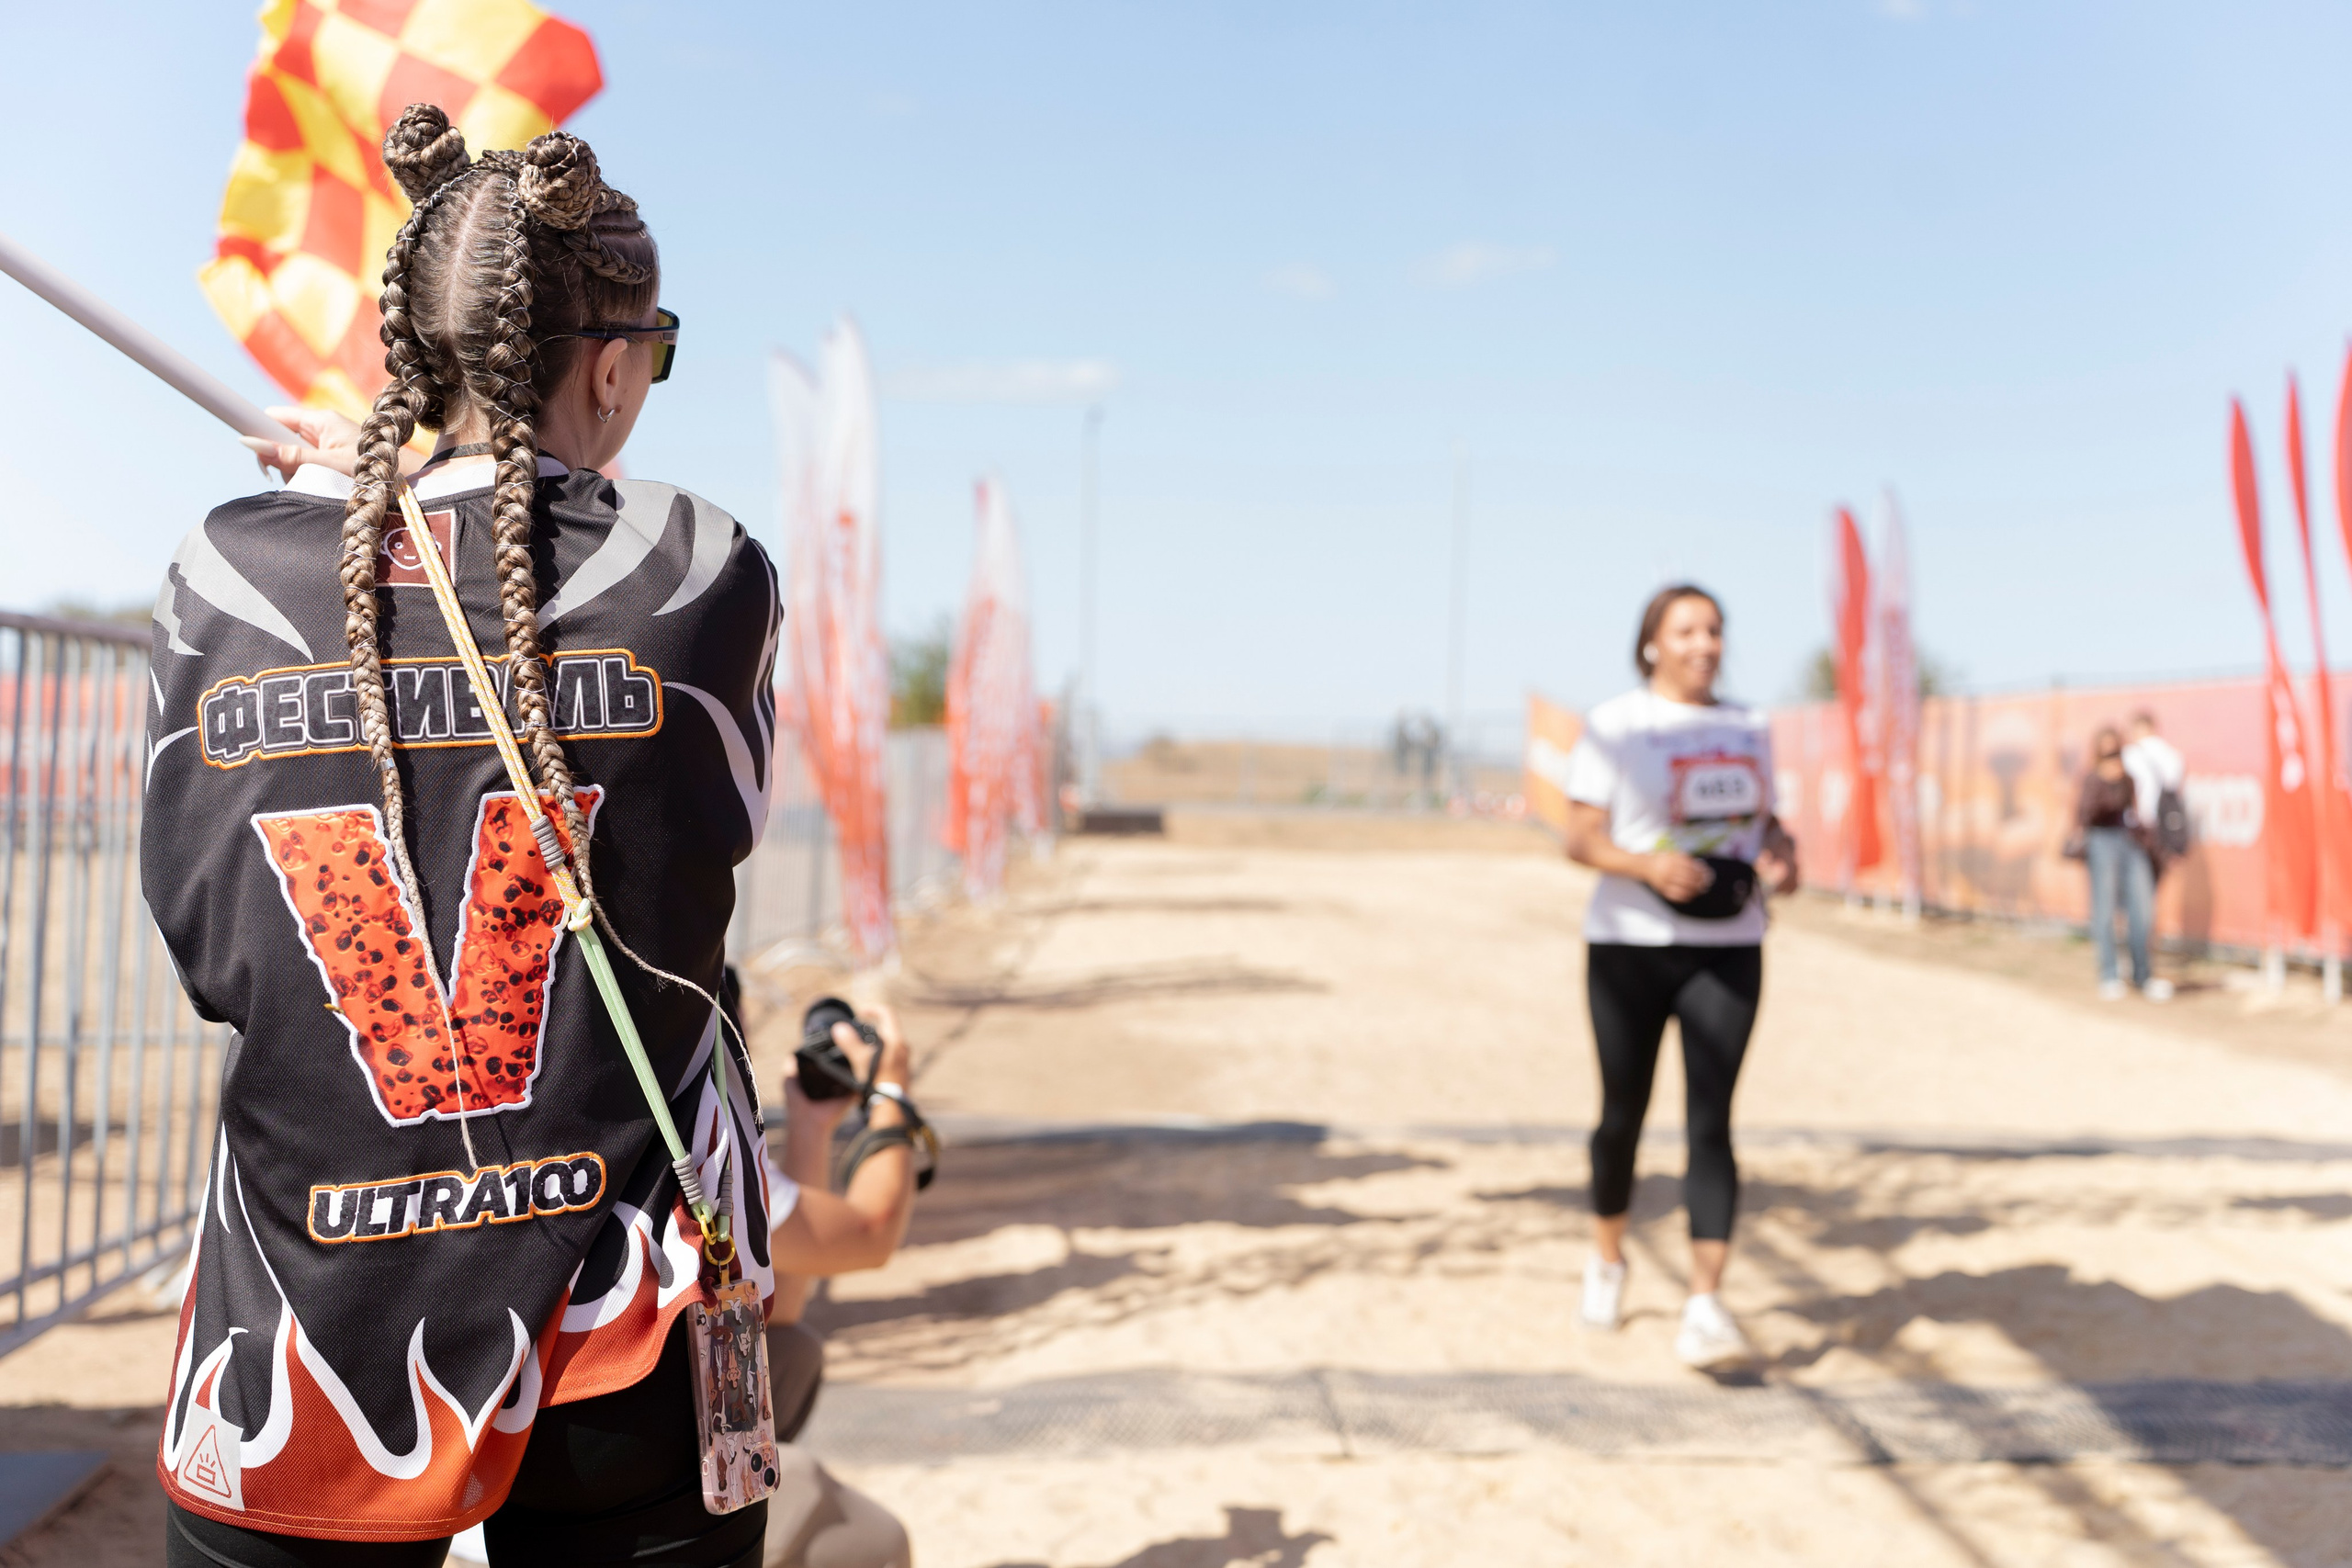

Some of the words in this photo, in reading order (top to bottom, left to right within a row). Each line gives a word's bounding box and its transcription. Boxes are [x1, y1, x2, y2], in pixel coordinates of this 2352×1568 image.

[201, 654, 656, 761] ФЕСИВЛЬ
[251, 784, 605, 1128] V
[311, 1156, 604, 1240] ULTRA100
